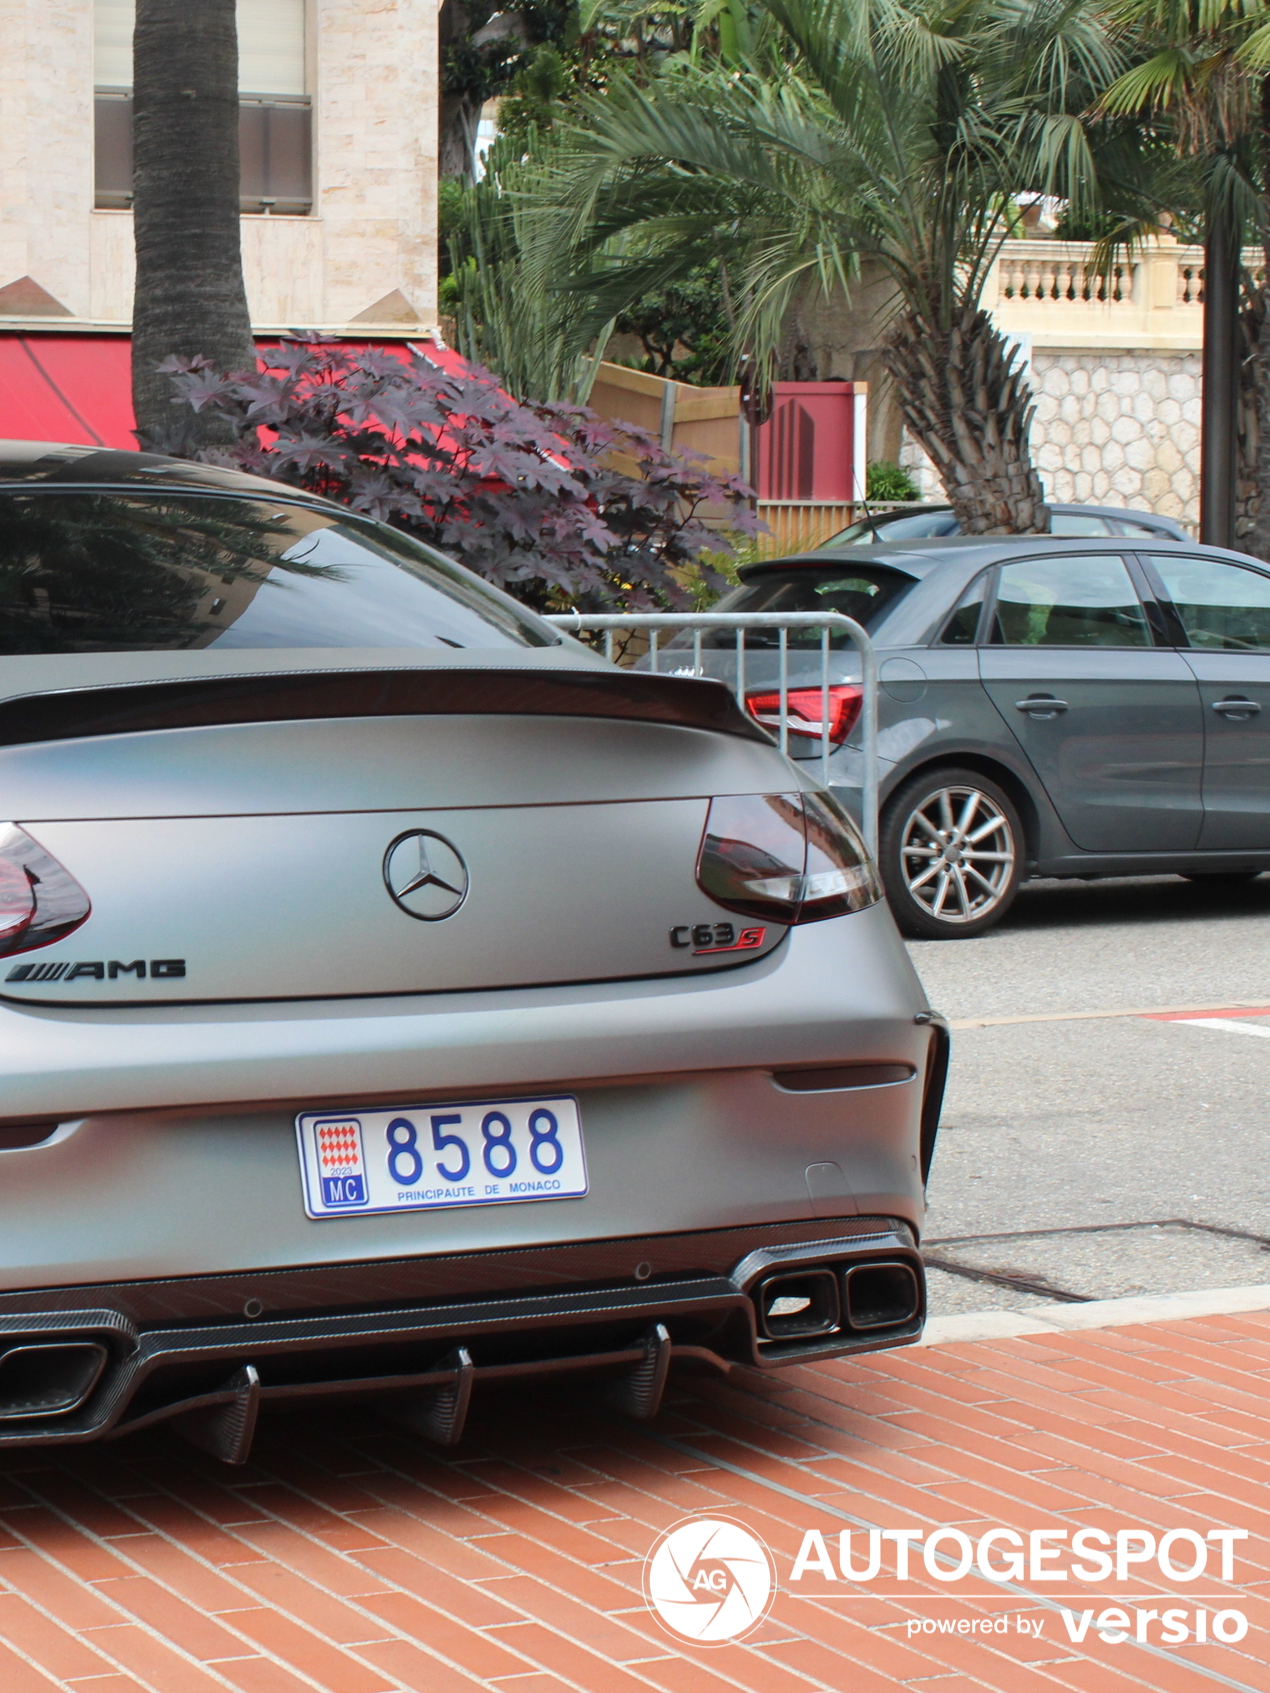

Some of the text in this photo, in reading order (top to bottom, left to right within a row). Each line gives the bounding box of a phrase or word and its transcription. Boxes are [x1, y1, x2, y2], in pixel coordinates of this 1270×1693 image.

[385, 1108, 563, 1186] 8588
[330, 1167, 353, 1177] 2023
[329, 1178, 358, 1202] MC
[397, 1179, 561, 1202] PRINCIPAUTE DE MONACO
